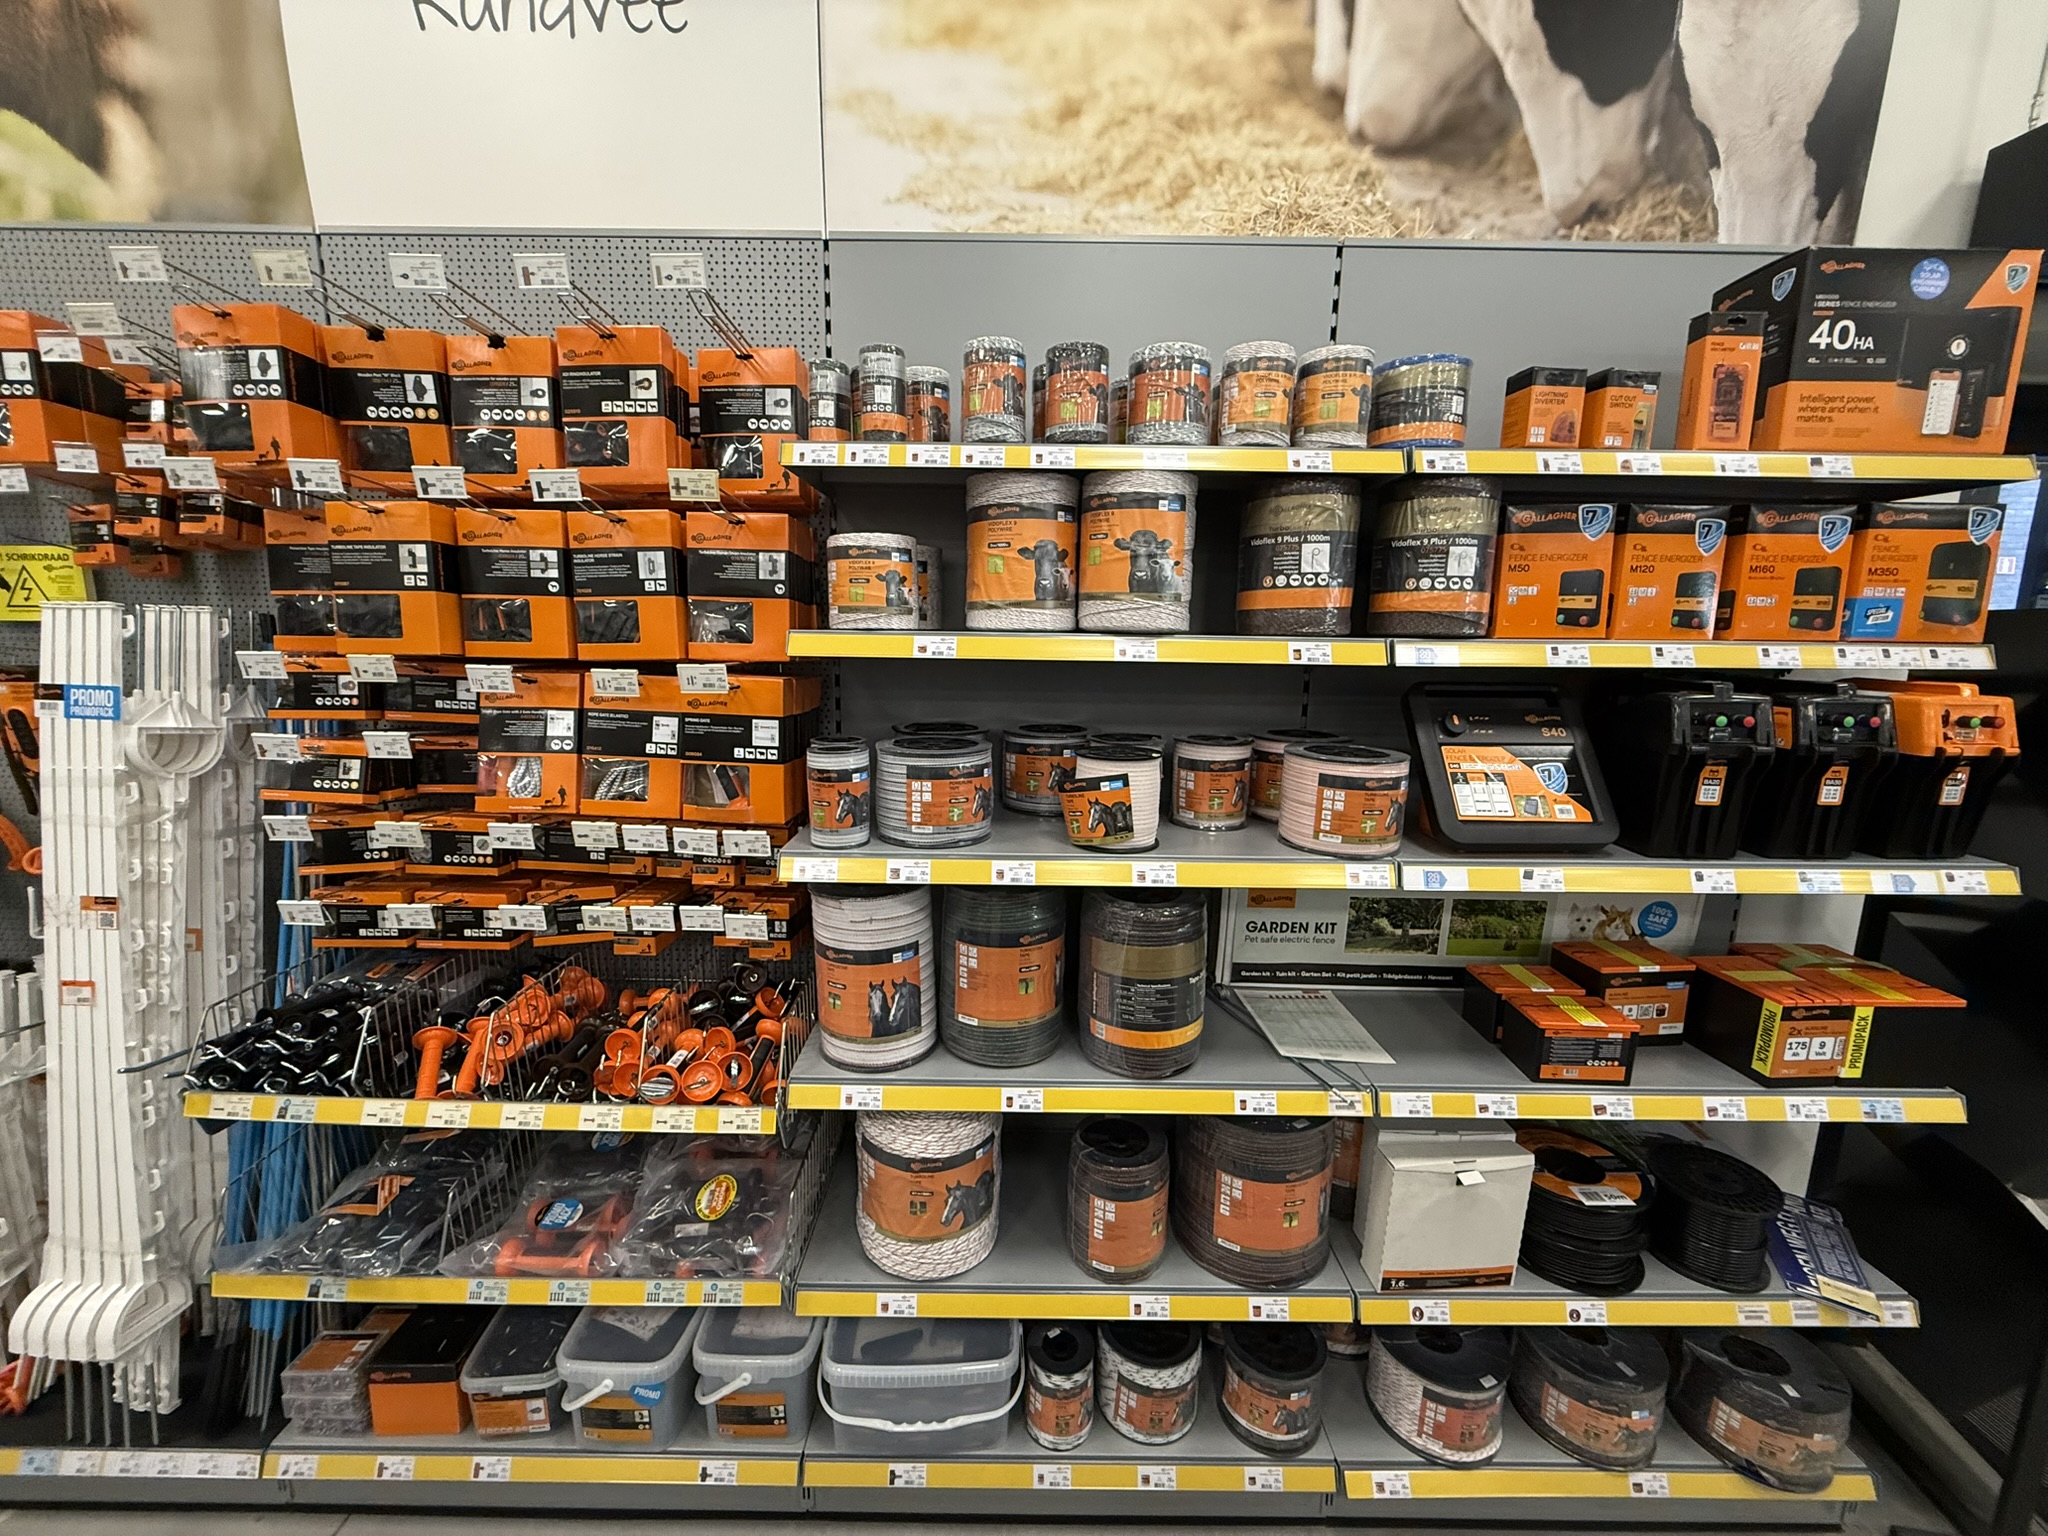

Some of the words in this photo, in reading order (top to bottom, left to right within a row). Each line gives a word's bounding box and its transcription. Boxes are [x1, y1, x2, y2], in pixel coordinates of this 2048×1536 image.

[563, 349, 603, 361] GALLAGHER
[452, 359, 492, 371] GALLAGHER
[702, 371, 741, 382] GALLAGHER
[1535, 391, 1568, 399] LIGHTNING
[1800, 393, 1846, 405] Intelligent
[1609, 401, 1634, 409] SWITCH
[1798, 405, 1828, 413] where
[1829, 405, 1846, 413] and
[1847, 405, 1870, 413] when
[1872, 405, 1879, 413] it
[1796, 414, 1834, 423] matters.
[1269, 502, 1312, 515] GALLAGHER
[1514, 510, 1578, 527] GALLAGHER
[1585, 509, 1599, 525] 7
[1638, 510, 1697, 527] GALLAGHER
[1757, 510, 1820, 527] GALLAGHER
[1877, 510, 1929, 524] GALLAGHER
[1974, 512, 1988, 528] 7
[331, 525, 373, 537] GALLAGHER
[1701, 524, 1714, 540] 7
[1824, 522, 1838, 537] 7
[462, 530, 503, 542] GALLAGHER
[573, 533, 613, 544] GALLAGHER
[691, 533, 733, 544] GALLAGHER
[1250, 536, 1276, 546] Vidoflex
[1276, 535, 1282, 544] 9
[1283, 535, 1299, 543] Plus
[1307, 534, 1331, 542] 1000m
[1391, 538, 1421, 548] Vidoflex
[1421, 538, 1428, 546] 9
[1430, 537, 1447, 545] Plus
[1455, 537, 1479, 545] 1000m
[1872, 545, 1900, 553] FENCE
[6, 552, 70, 562] SCHRIKDRAAD
[1508, 554, 1539, 562] FENCE
[1539, 553, 1589, 562] ENERGIZER
[1631, 554, 1659, 563] FENCE
[1660, 555, 1704, 563] ENERGIZER
[1750, 554, 1779, 563] FENCE
[1780, 554, 1827, 563] ENERGIZER
[1870, 554, 1918, 563] ENERGIZER
[1508, 564, 1530, 573] M50
[1629, 565, 1655, 574] M120
[1749, 564, 1776, 574] M160
[1867, 567, 1900, 577] M350
[70, 688, 114, 706] PROMO
[687, 697, 728, 709] GALLAGHER
[70, 705, 115, 718] PROMOPACK
[1541, 727, 1567, 737] S40
[1541, 768, 1553, 782] 7
[1651, 905, 1673, 917] 100%
[1647, 913, 1670, 925] SAFE
[1245, 920, 1310, 933] GARDEN
[1314, 922, 1338, 934] KIT
[1244, 934, 1258, 943] Pet
[1259, 935, 1279, 943] safe
[1279, 935, 1311, 944] electric
[1312, 936, 1336, 944] fence
[1755, 1008, 1778, 1066] PROMOPACK
[1788, 1026, 1803, 1036] 2x
[1787, 1041, 1808, 1051] 175
[1818, 1040, 1827, 1050] 9
[1848, 1015, 1871, 1069] PROMOPACK
[716, 1182, 727, 1211] PROMO
[542, 1202, 567, 1225] PROMO
[556, 1207, 574, 1224] PACK
[634, 1387, 661, 1400] PROMO
